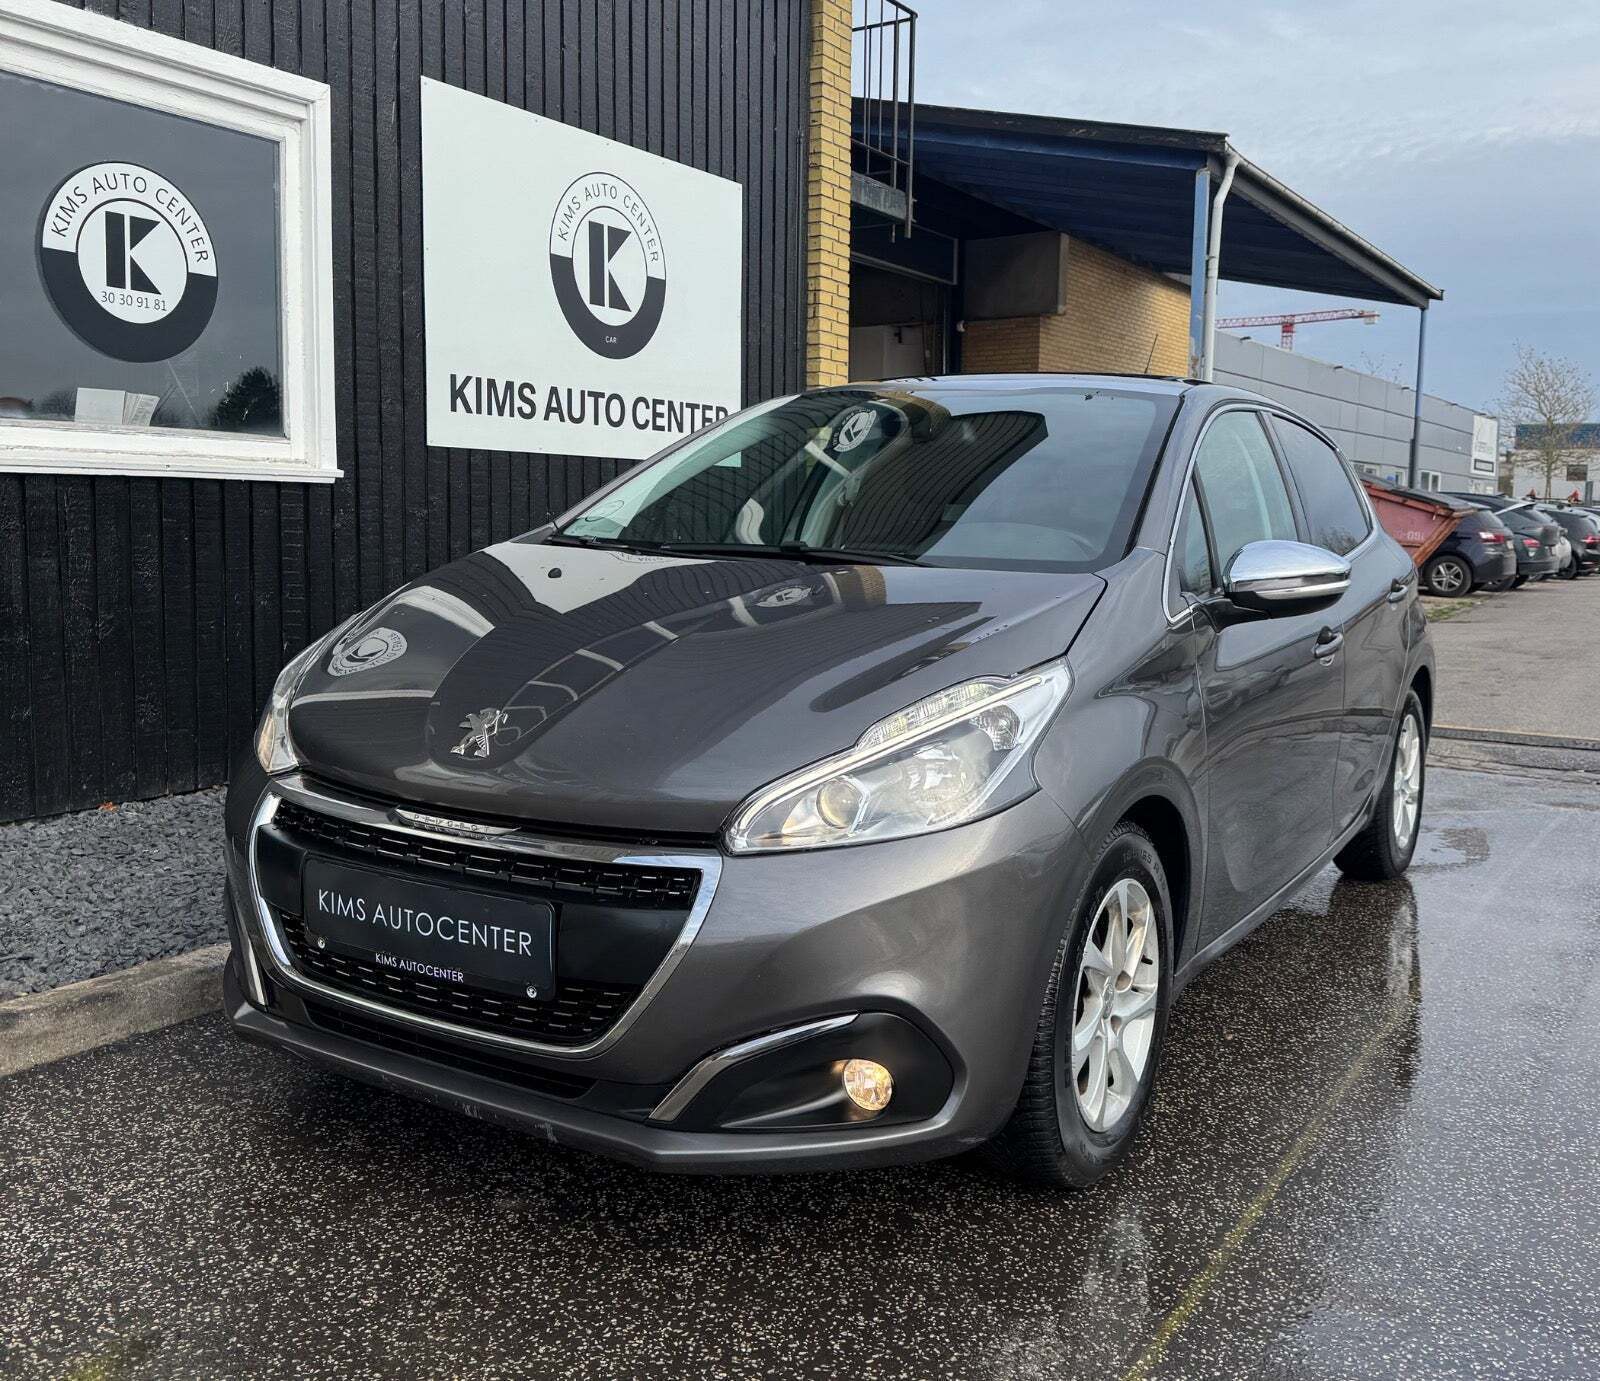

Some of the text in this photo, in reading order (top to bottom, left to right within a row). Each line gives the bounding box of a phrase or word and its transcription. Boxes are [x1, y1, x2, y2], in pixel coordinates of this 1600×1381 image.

[51, 172, 209, 263] KIMS AUTO CENTER
[558, 183, 660, 263] KIMS AUTO CENTER
[105, 210, 162, 296] K
[588, 220, 632, 313] K
[101, 291, 168, 312] 30 30 91 81
[605, 335, 618, 345] CAR
[449, 373, 538, 420] KIMS
[543, 385, 627, 429] AUTO
[318, 888, 533, 958] KIMS AUTOCENTER
[375, 951, 464, 984] KIMS AUTOCENTER
